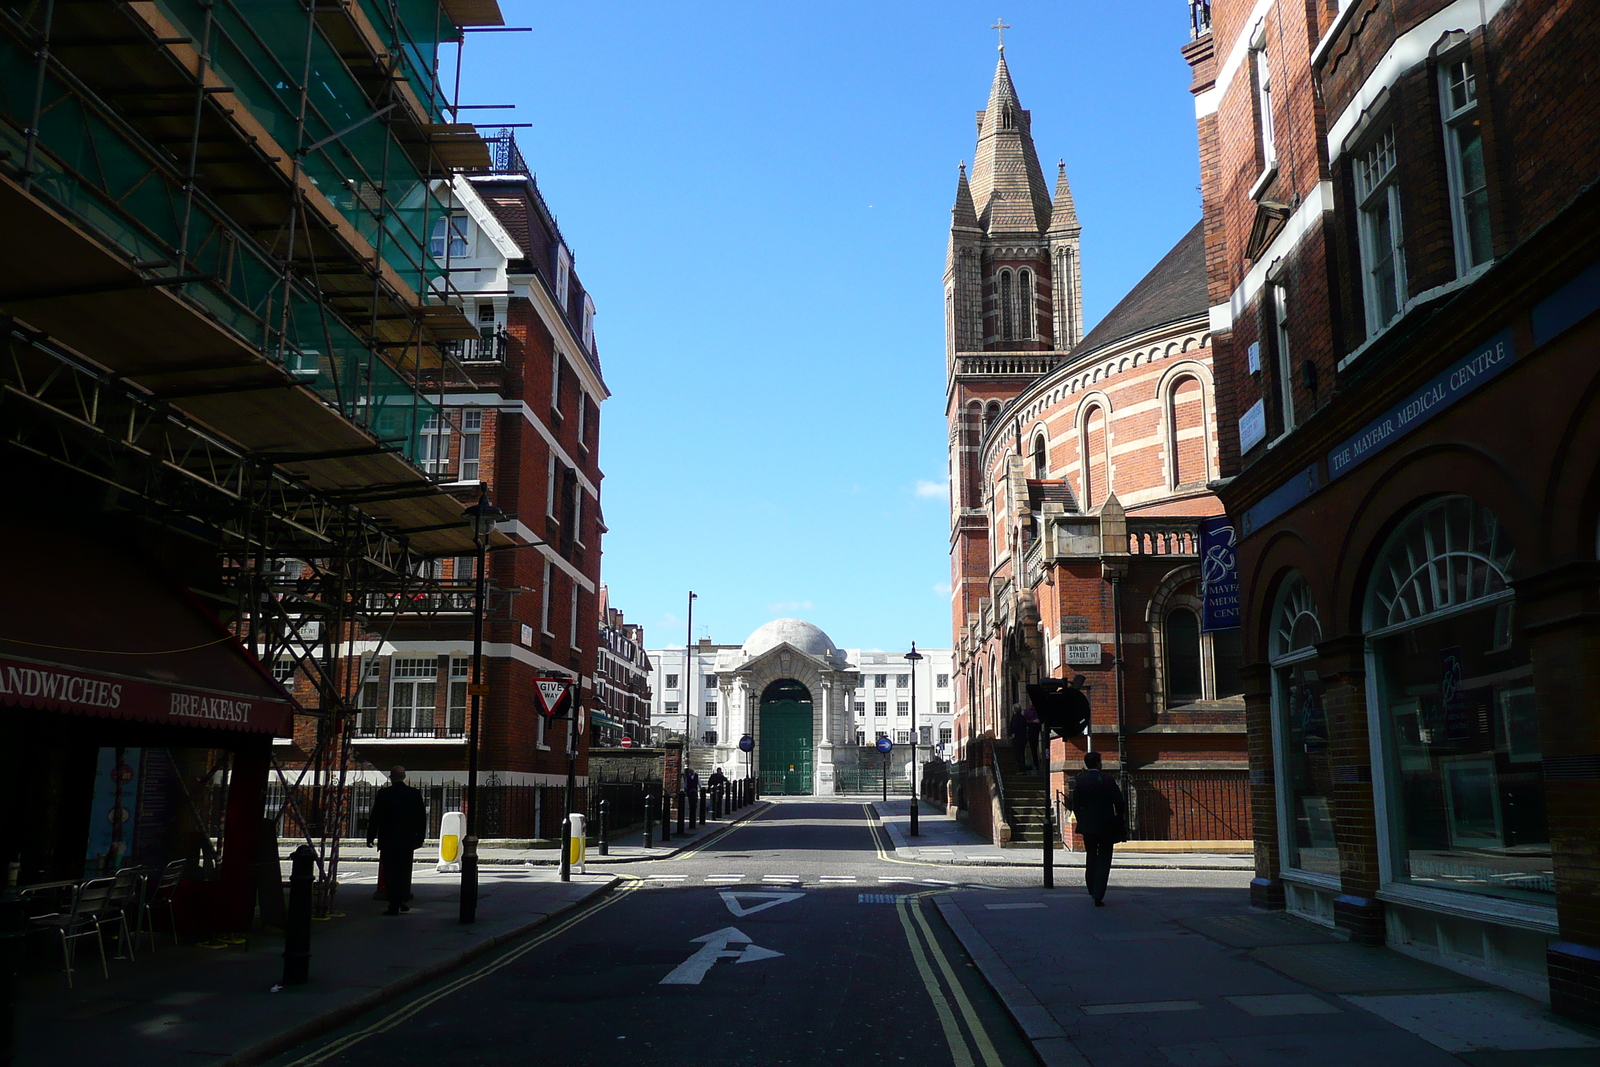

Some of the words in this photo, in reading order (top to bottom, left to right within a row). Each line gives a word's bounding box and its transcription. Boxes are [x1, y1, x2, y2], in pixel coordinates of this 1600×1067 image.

[1332, 448, 1351, 470] THE
[1353, 419, 1395, 457] MAYFAIR
[1396, 383, 1446, 428] MEDICAL
[1450, 341, 1506, 391] CENTRE
[540, 683, 563, 692] GIVE
[168, 692, 252, 723] BREAKFAST
